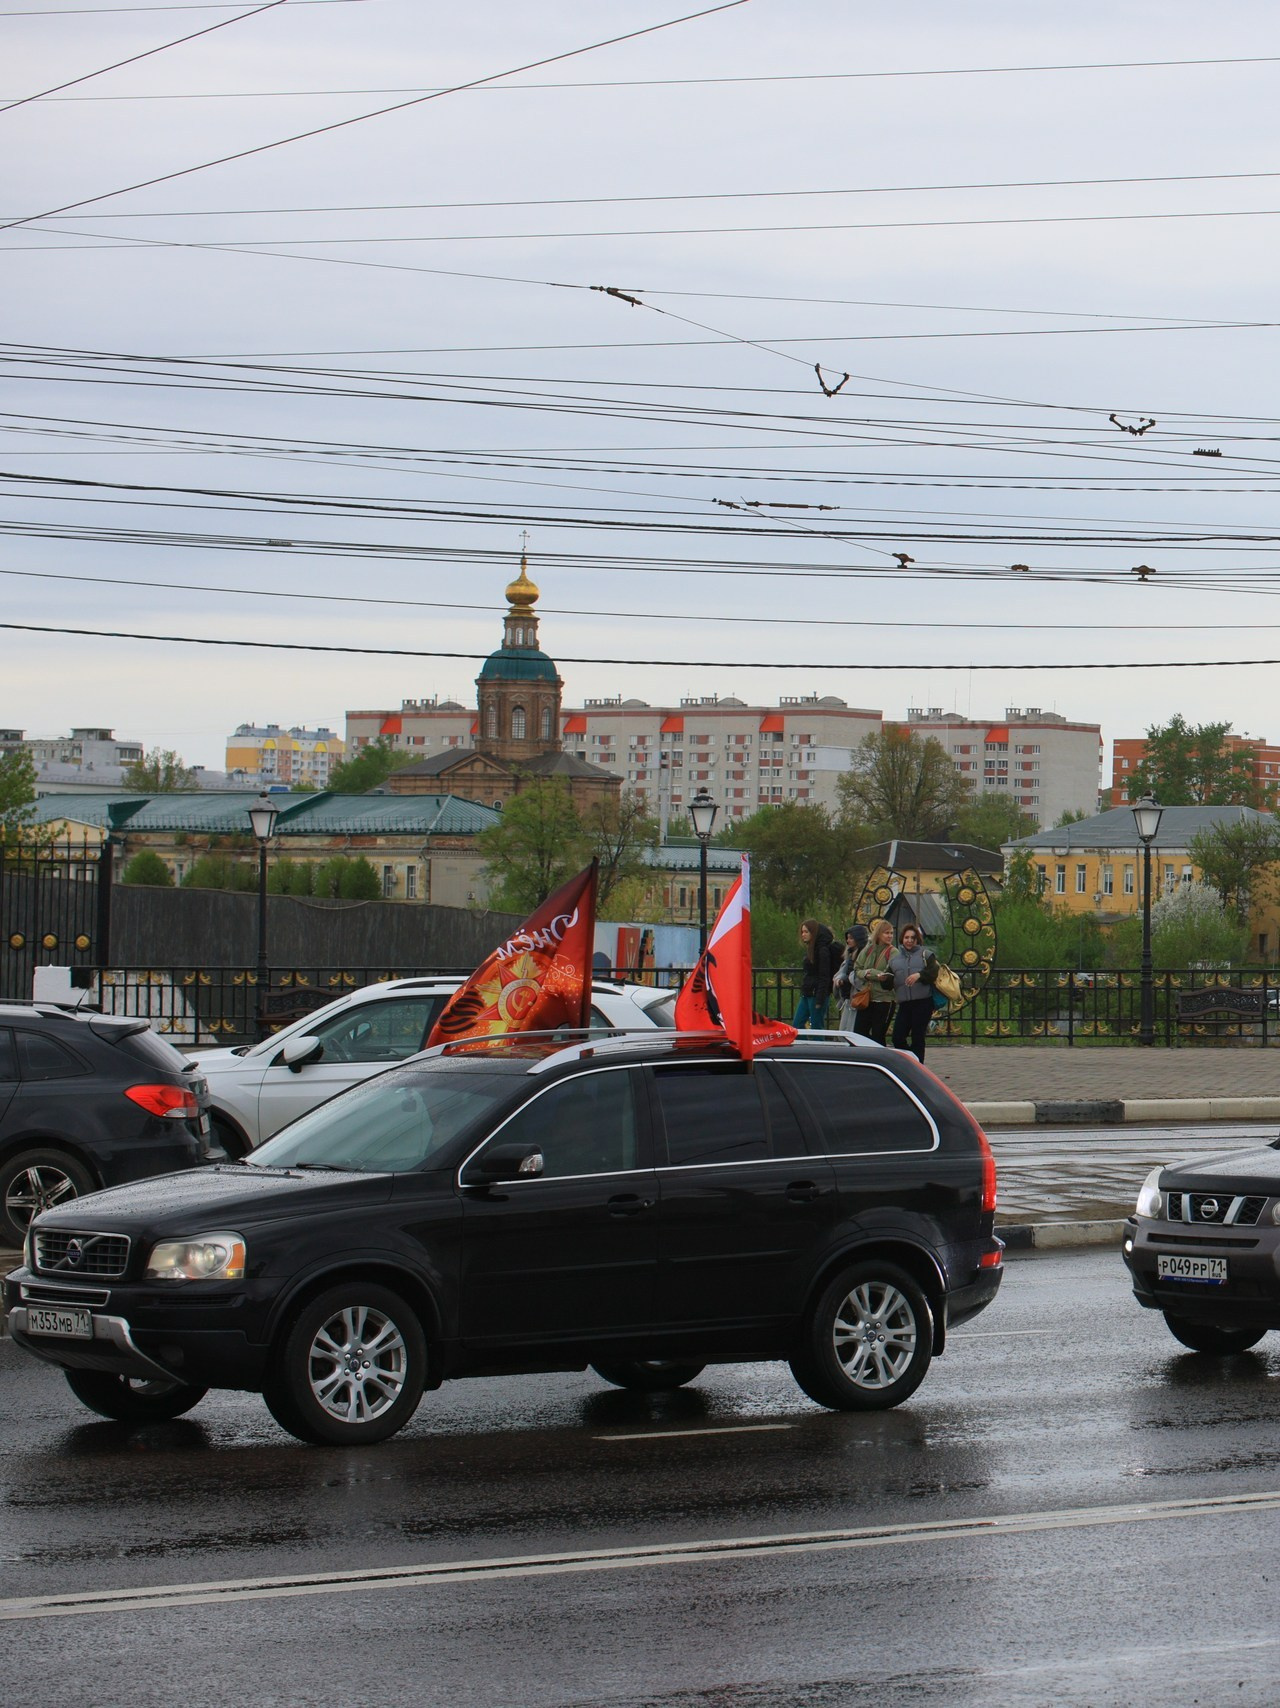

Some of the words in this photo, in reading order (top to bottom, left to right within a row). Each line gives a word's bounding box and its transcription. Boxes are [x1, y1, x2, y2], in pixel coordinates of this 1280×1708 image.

[1162, 1258, 1208, 1276] Р049РР
[1210, 1260, 1223, 1273] 71
[31, 1311, 73, 1332] М353МВ
[75, 1313, 87, 1329] 71
